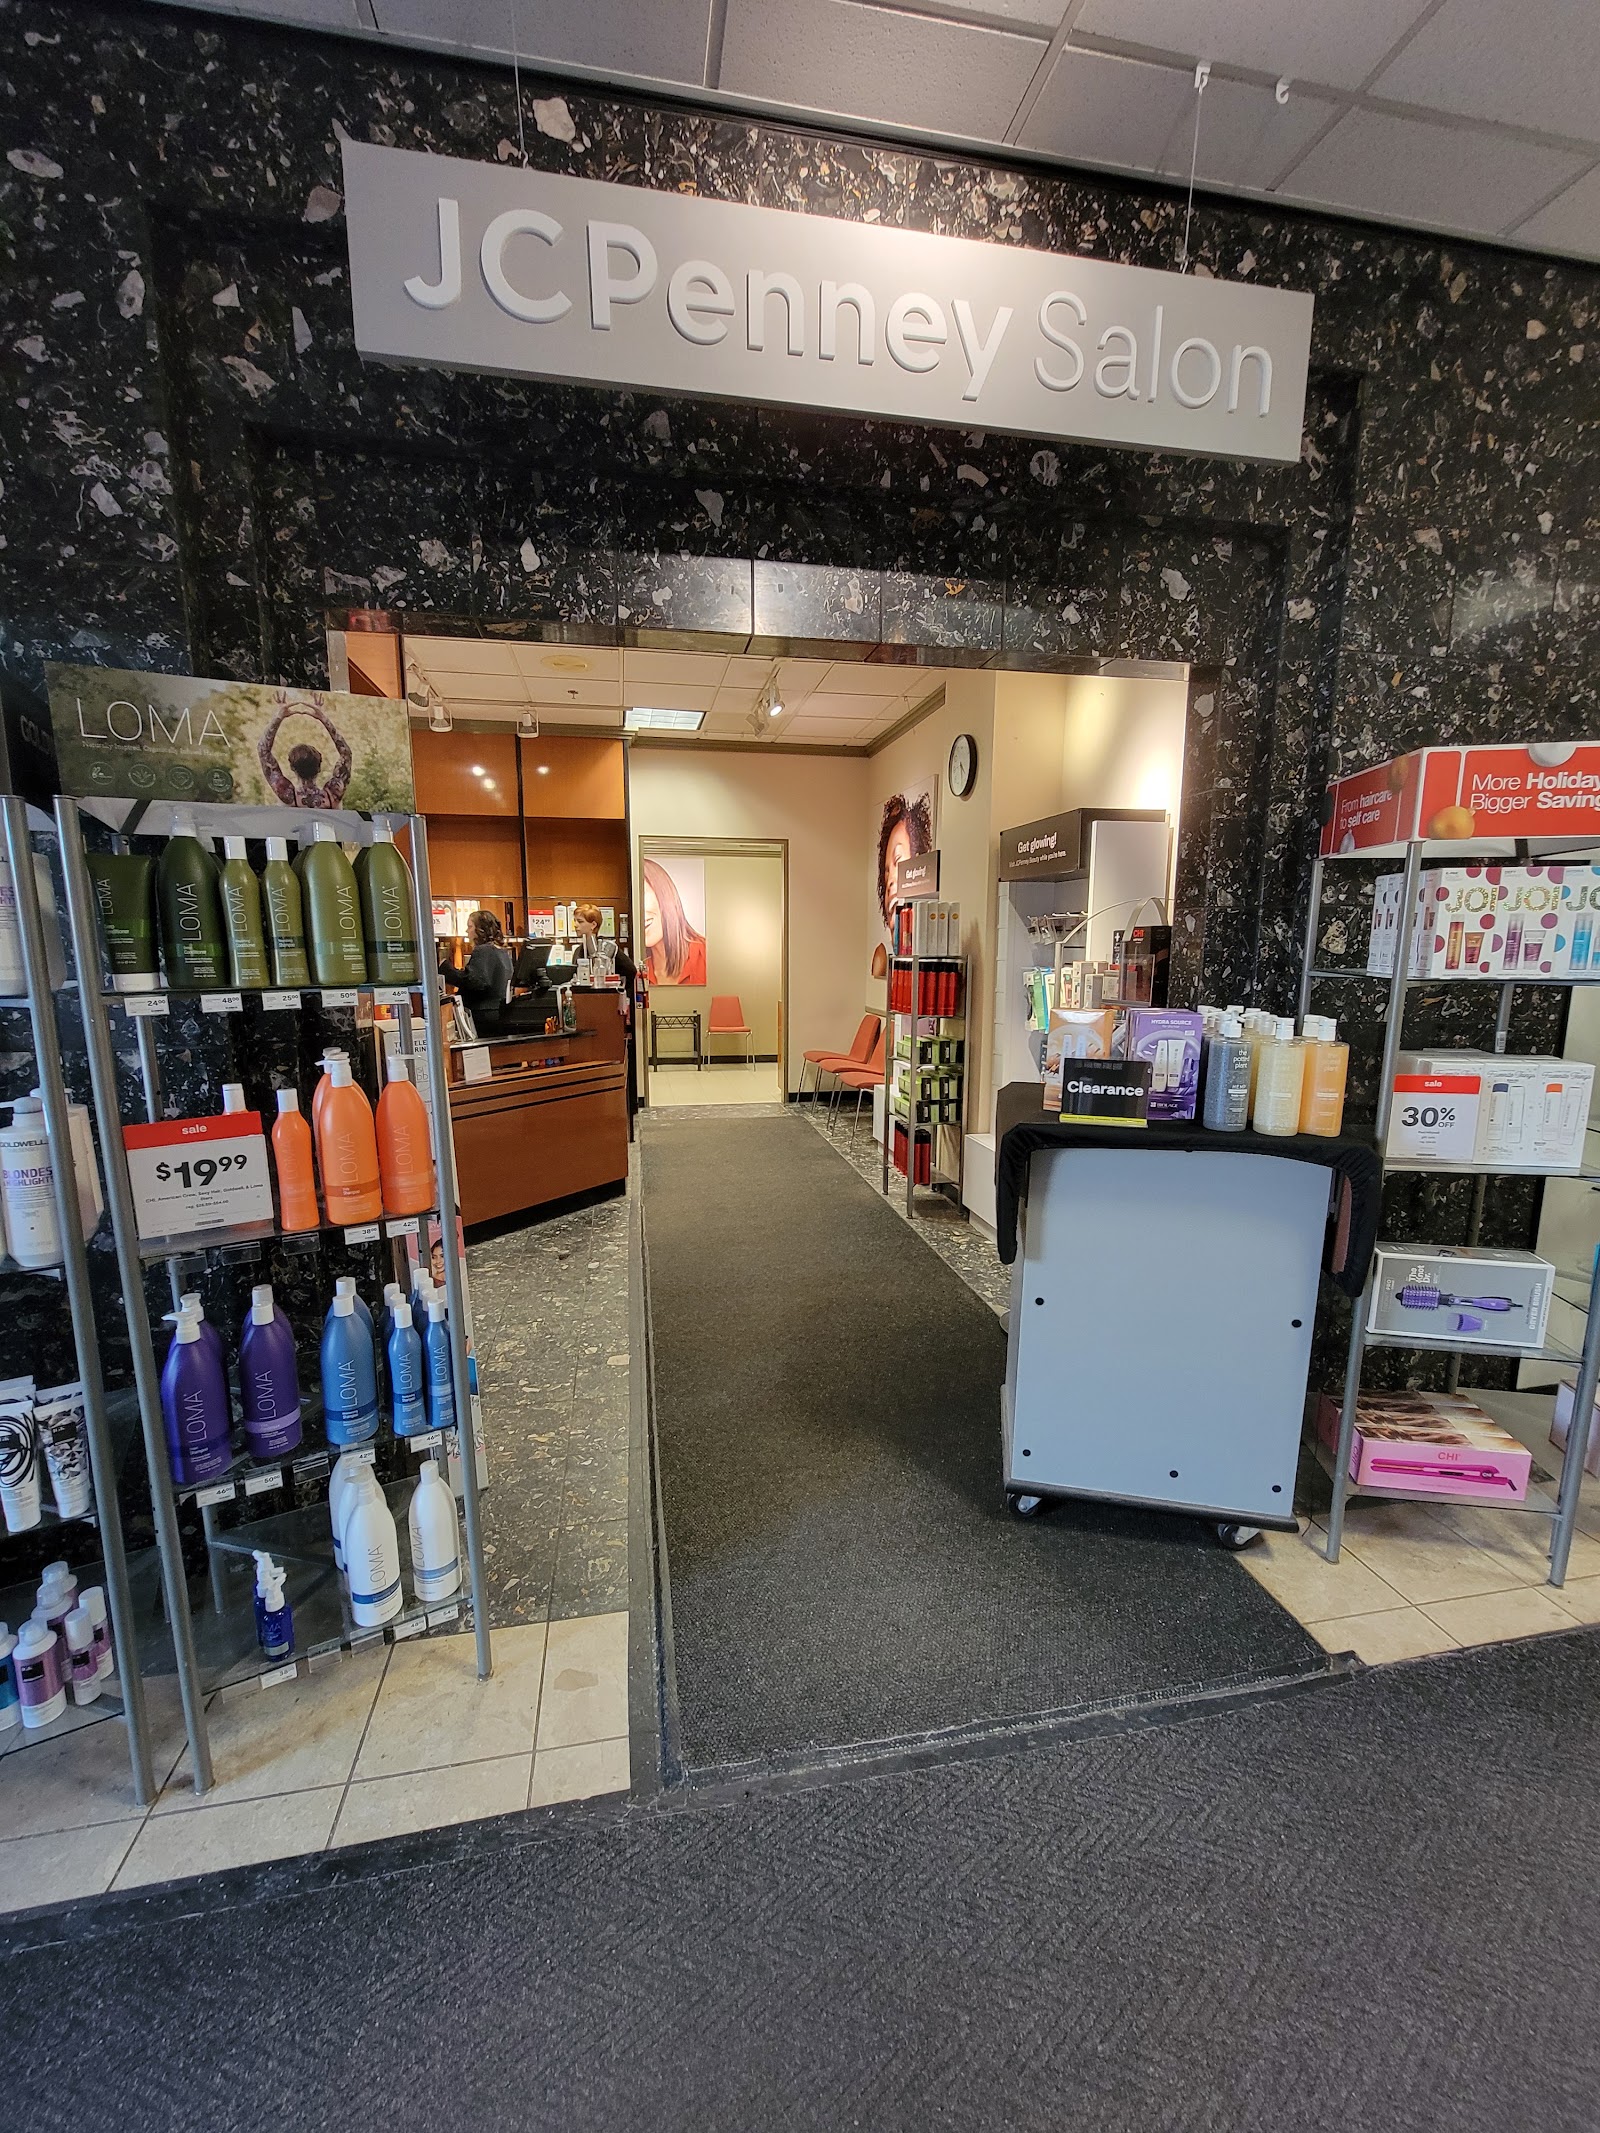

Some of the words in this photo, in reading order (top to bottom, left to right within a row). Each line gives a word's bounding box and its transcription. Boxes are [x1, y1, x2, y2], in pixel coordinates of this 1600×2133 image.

[402, 197, 1012, 402] JCPenney
[1033, 289, 1274, 418] Salon
[76, 697, 231, 748] LOMA
[1472, 774, 1521, 791] More
[1526, 771, 1600, 792] Holiday
[1341, 799, 1359, 814] From
[1360, 790, 1393, 809] haircare
[1470, 793, 1532, 814] Bigger
[1340, 816, 1347, 830] to
[1347, 811, 1362, 828] self
[1362, 810, 1380, 824] care
[1017, 840, 1030, 854] Get
[1030, 832, 1058, 854] glowing!
[905, 869, 913, 879] Get
[97, 878, 114, 915] LOMA
[228, 886, 248, 932] LOMA
[176, 883, 202, 940] LOMA
[271, 887, 291, 932] LOMA
[336, 885, 357, 940] LOMA
[382, 885, 403, 940] LOMA
[1132, 929, 1145, 938] CHI
[1234, 1062, 1248, 1070] plant
[1066, 1080, 1144, 1097] Clearance
[1424, 1079, 1442, 1088] sale
[181, 1123, 208, 1135] sale
[1401, 1106, 1456, 1128] 30%
[337, 1131, 359, 1184] LOMA
[393, 1125, 414, 1174] LOMA
[3, 1166, 53, 1179] BLONDES
[1408, 1267, 1417, 1282] The
[1416, 1265, 1425, 1284] Knot
[1532, 1283, 1543, 1307] BRUSH
[1528, 1306, 1539, 1331] DRYER
[398, 1352, 413, 1390] LOMA
[433, 1345, 448, 1382] LOMA
[254, 1369, 277, 1421] LOMA
[338, 1359, 358, 1409] LOMA
[183, 1389, 208, 1444] LOMA
[1437, 1451, 1460, 1461] CHI
[412, 1523, 426, 1569] LOMA
[367, 1543, 387, 1592] LOMA
